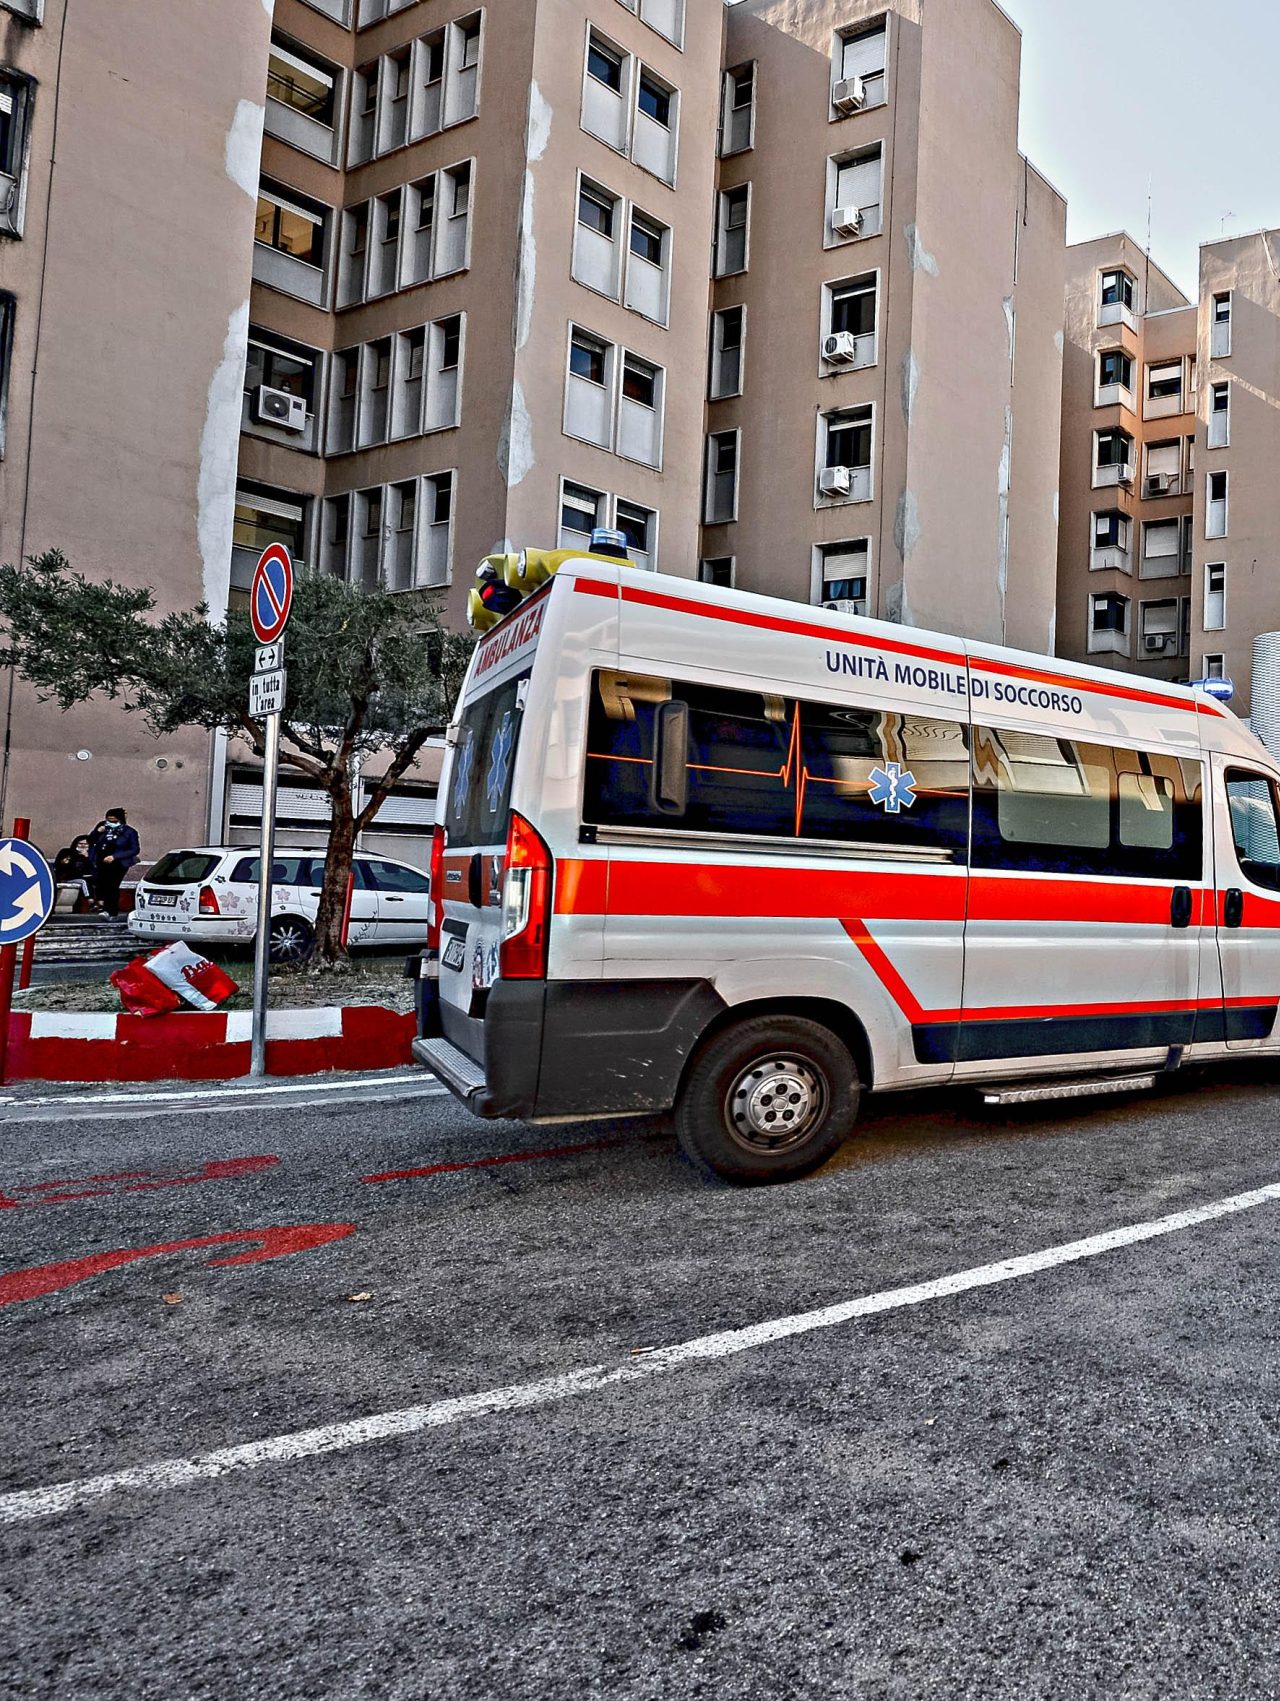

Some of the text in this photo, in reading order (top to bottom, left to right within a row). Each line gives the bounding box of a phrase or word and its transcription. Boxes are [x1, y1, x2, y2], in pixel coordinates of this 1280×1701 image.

[474, 604, 544, 679] AMBULANZA
[252, 675, 279, 696] in tutta
[255, 695, 275, 712] l'area
[826, 651, 1083, 714] UNITÀ MOBILE DI SOCCORSO
